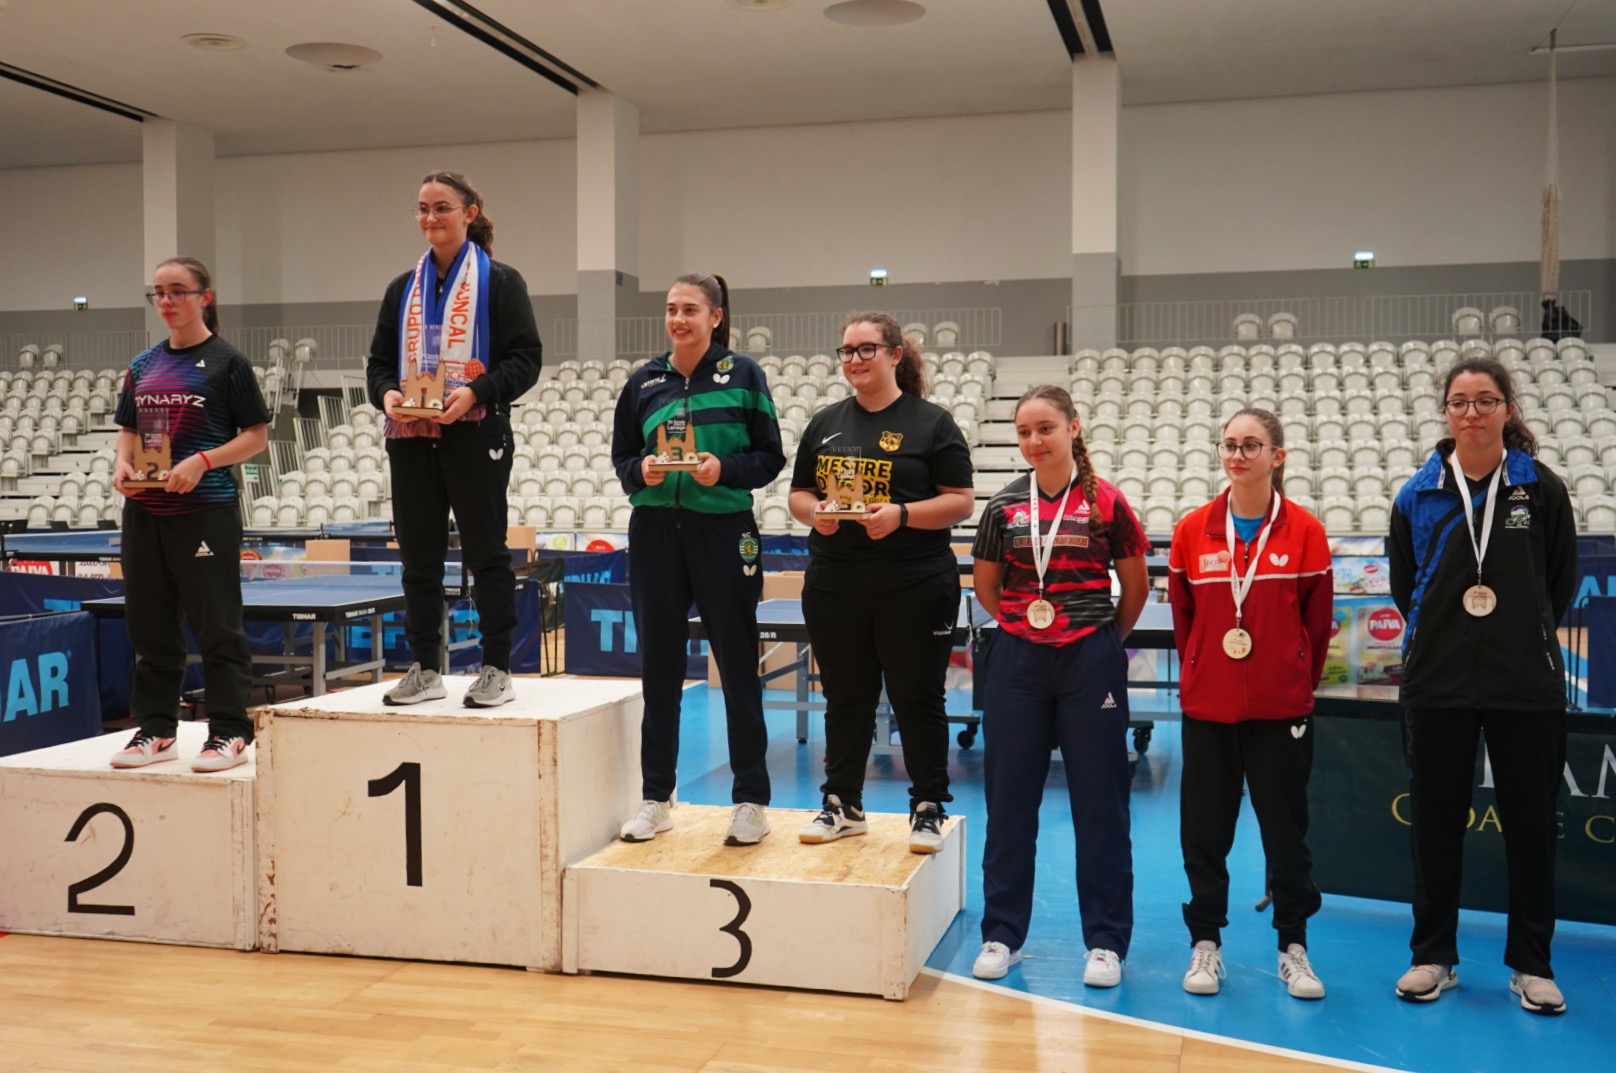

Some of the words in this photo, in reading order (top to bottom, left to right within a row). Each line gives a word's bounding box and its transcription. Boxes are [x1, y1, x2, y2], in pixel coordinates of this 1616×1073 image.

[1369, 618, 1402, 631] PAIVA
[63, 802, 136, 916] 2
[367, 761, 423, 887] 1
[709, 878, 752, 979] 3
